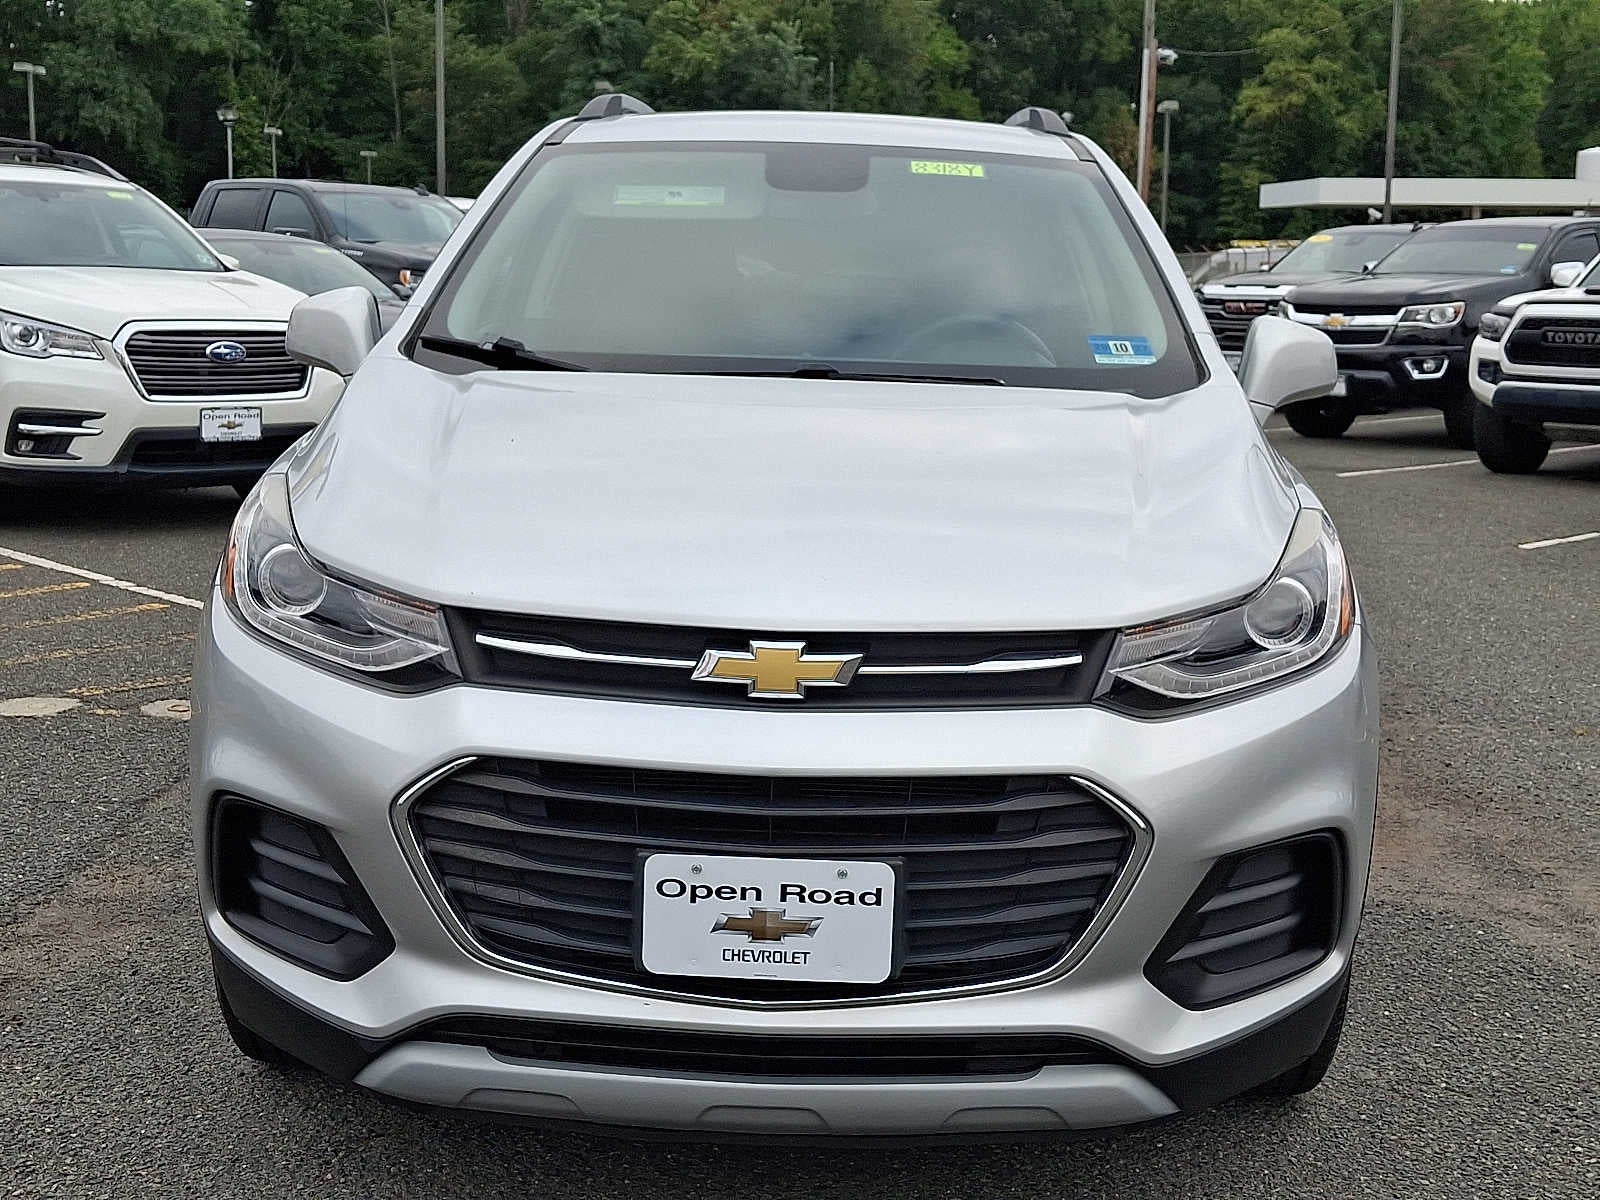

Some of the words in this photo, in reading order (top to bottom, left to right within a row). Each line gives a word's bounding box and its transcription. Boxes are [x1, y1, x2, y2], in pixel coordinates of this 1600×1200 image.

[1113, 343, 1129, 353] 10
[203, 413, 230, 421] Open
[655, 878, 763, 904] Open
[779, 883, 883, 907] Road
[722, 948, 811, 965] CHEVROLET
